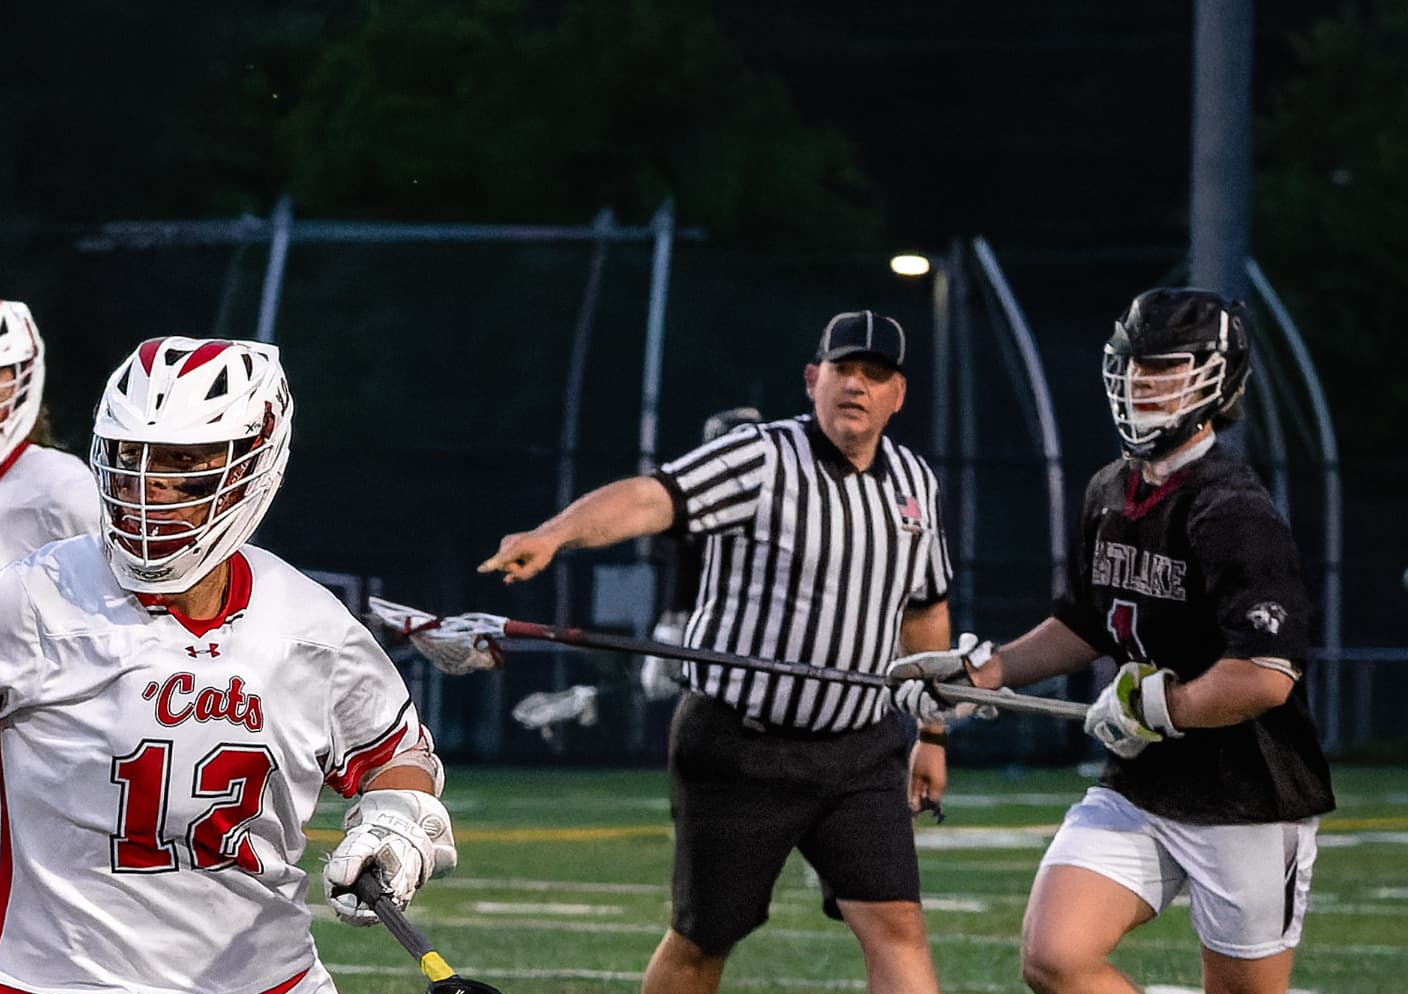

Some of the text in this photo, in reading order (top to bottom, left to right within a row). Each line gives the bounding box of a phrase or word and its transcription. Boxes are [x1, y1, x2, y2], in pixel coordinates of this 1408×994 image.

[1107, 598, 1150, 663] 1
[142, 671, 264, 733] 'Cats
[110, 738, 279, 875] 12
